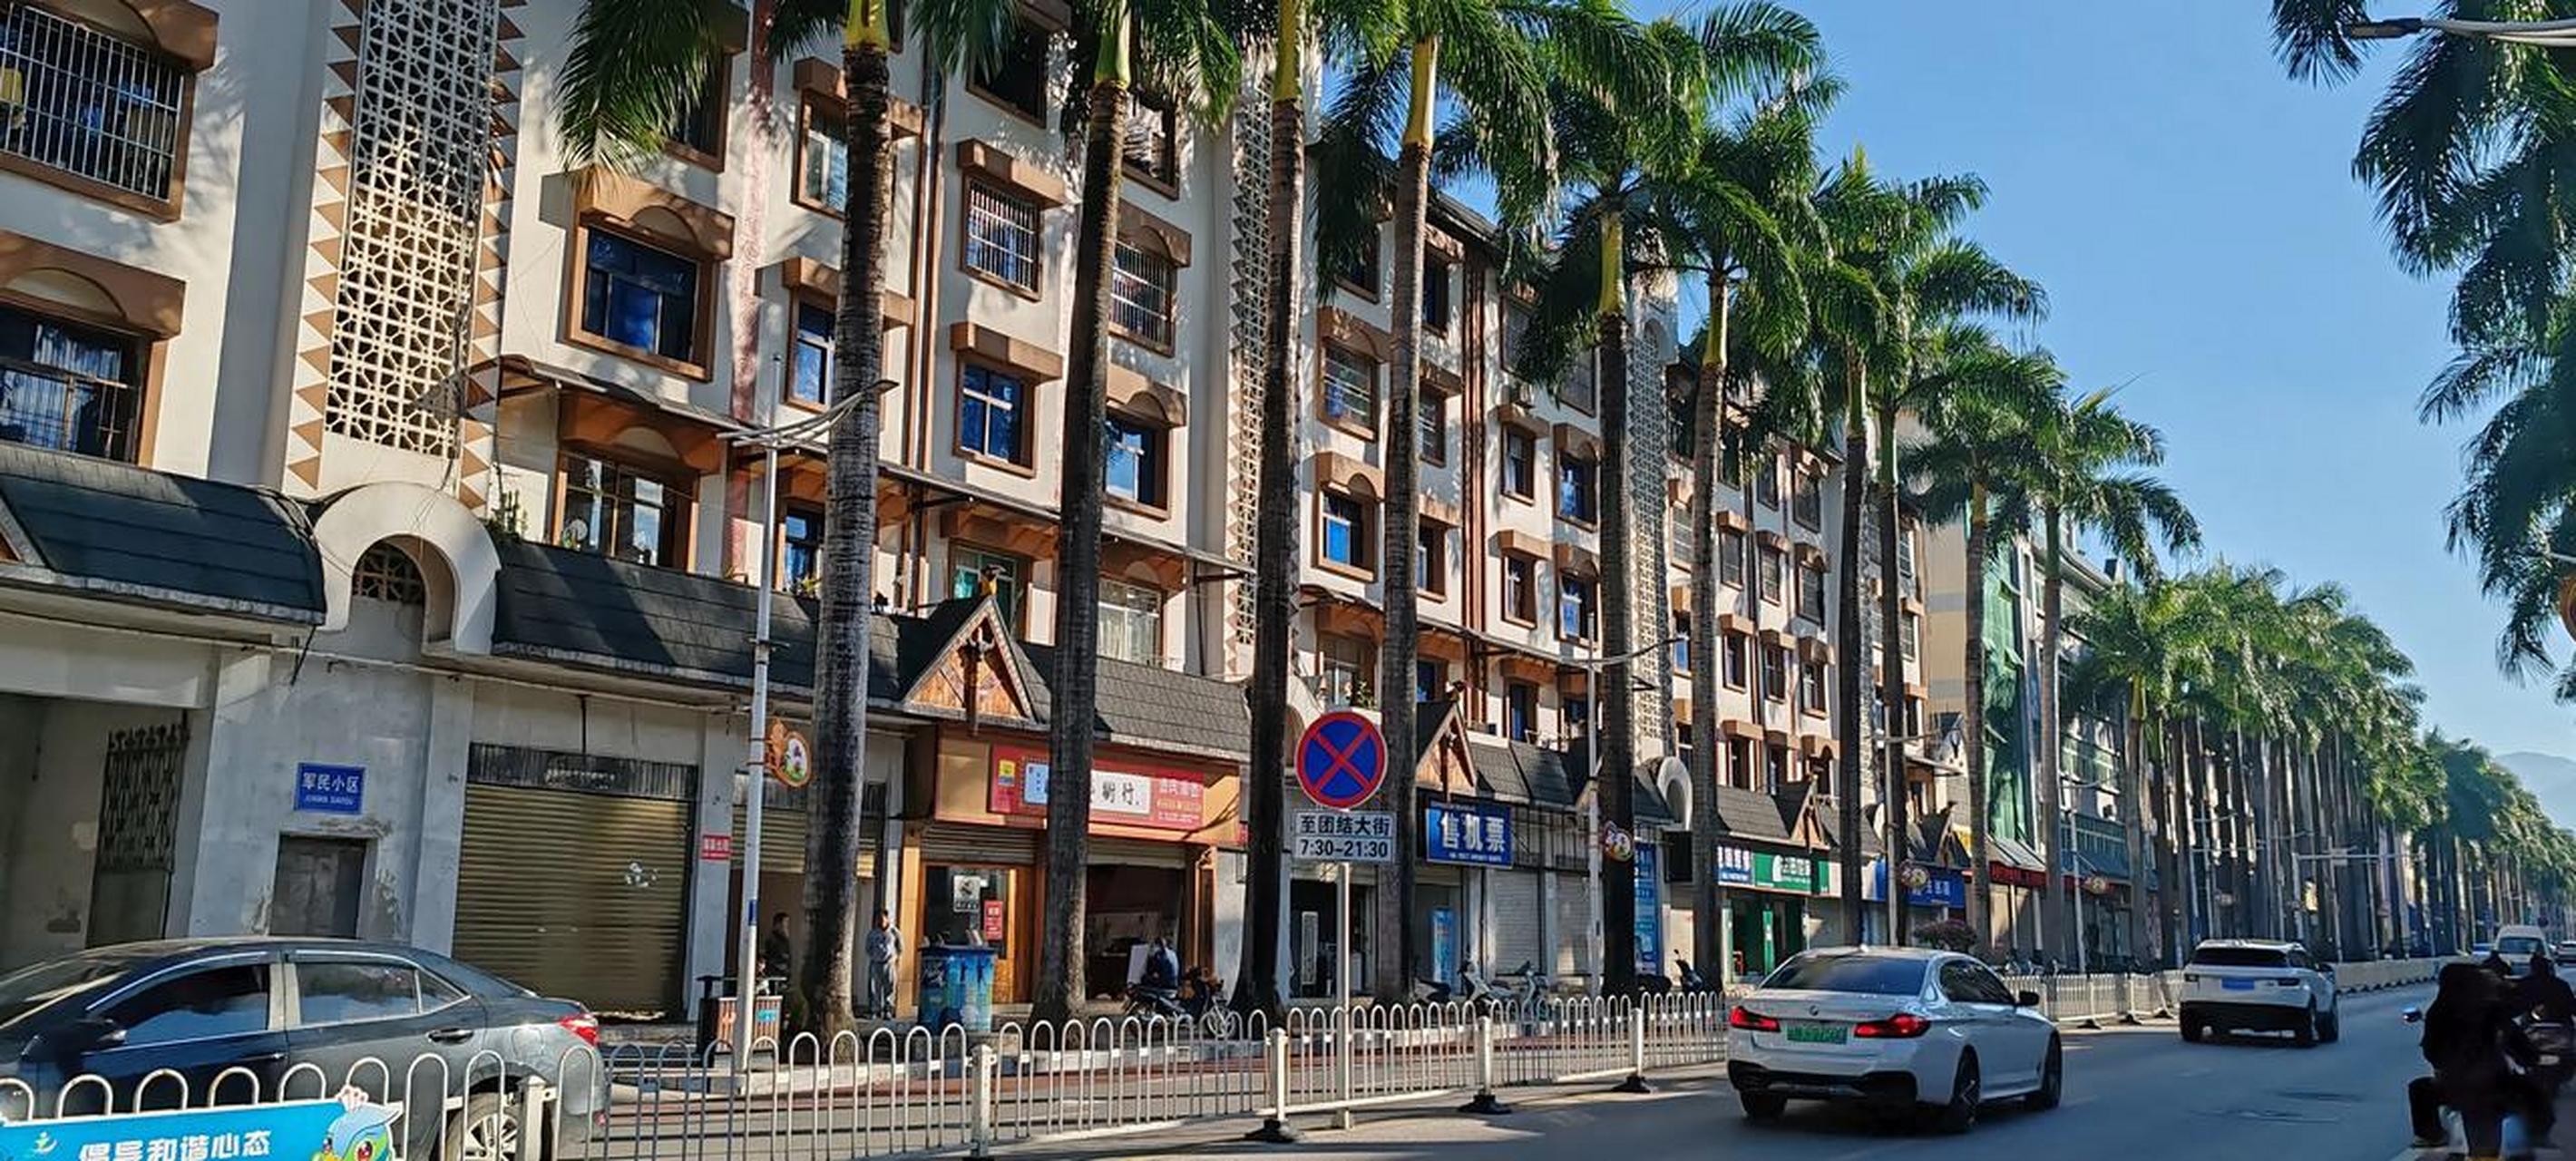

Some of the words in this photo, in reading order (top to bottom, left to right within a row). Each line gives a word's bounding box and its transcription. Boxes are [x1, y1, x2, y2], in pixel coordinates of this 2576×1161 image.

[303, 772, 359, 793] 军民小区
[1300, 815, 1390, 834] 至团结大街
[1300, 839, 1388, 858] 7:30-21:30
[79, 1130, 271, 1161] 倡导和谐心态
